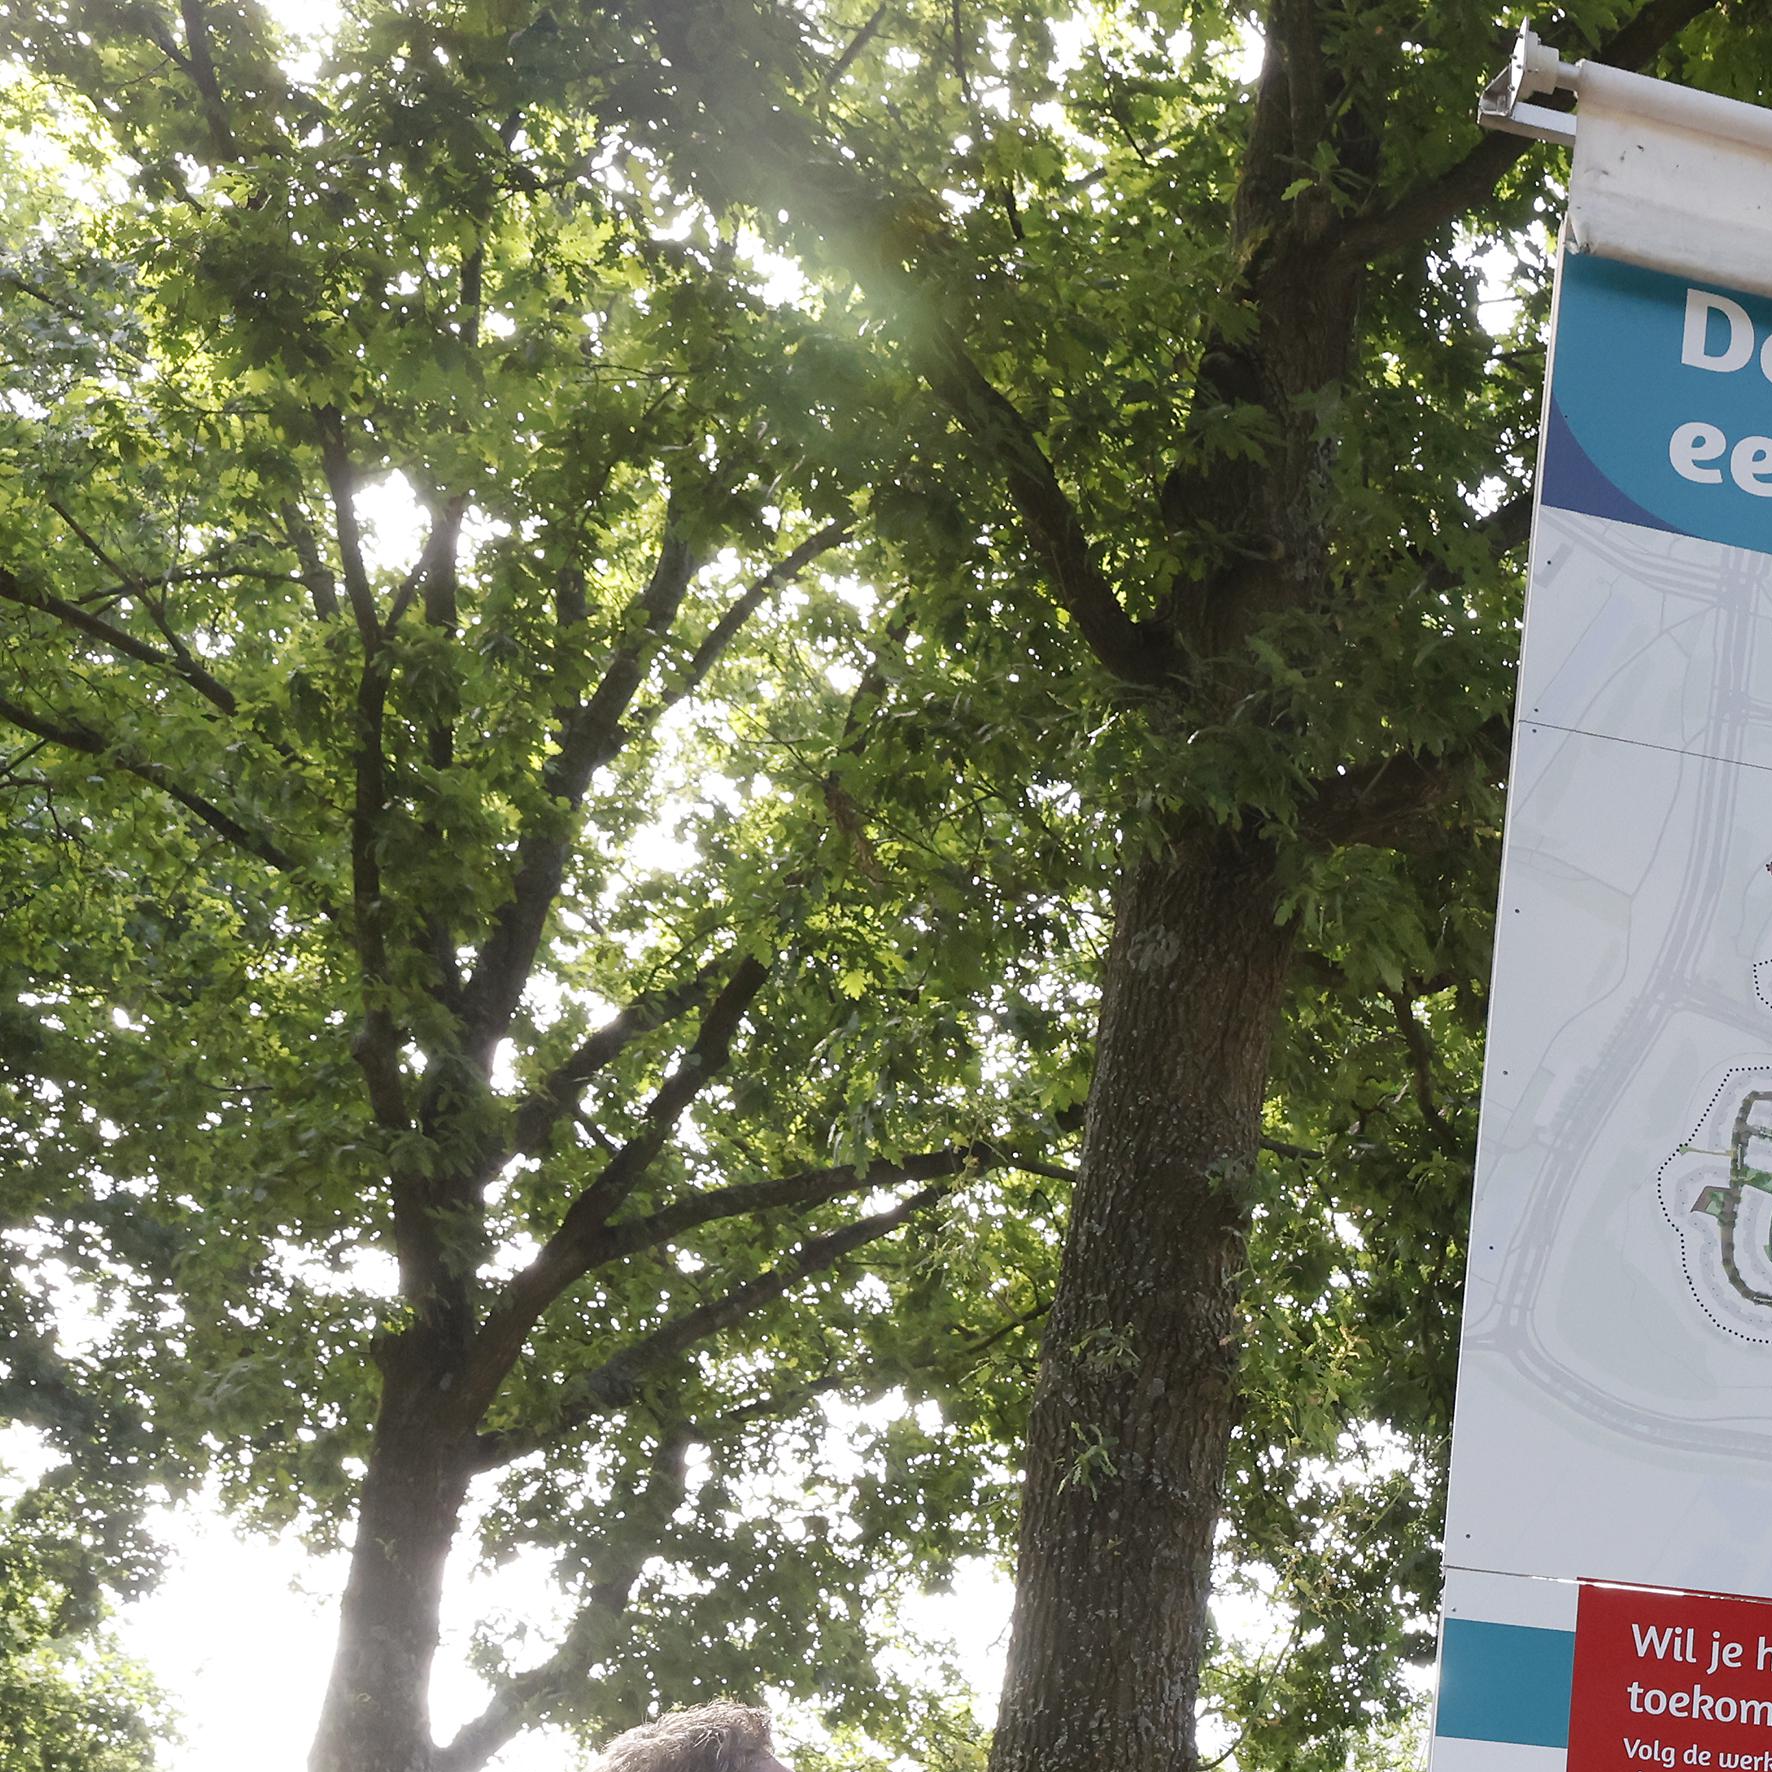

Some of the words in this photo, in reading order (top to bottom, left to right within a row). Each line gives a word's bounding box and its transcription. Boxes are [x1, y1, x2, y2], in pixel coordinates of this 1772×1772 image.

[1631, 1623, 1697, 1663] Wil
[1706, 1631, 1743, 1675] je
[1623, 1737, 1675, 1769] Volg
[1683, 1744, 1712, 1766] de
